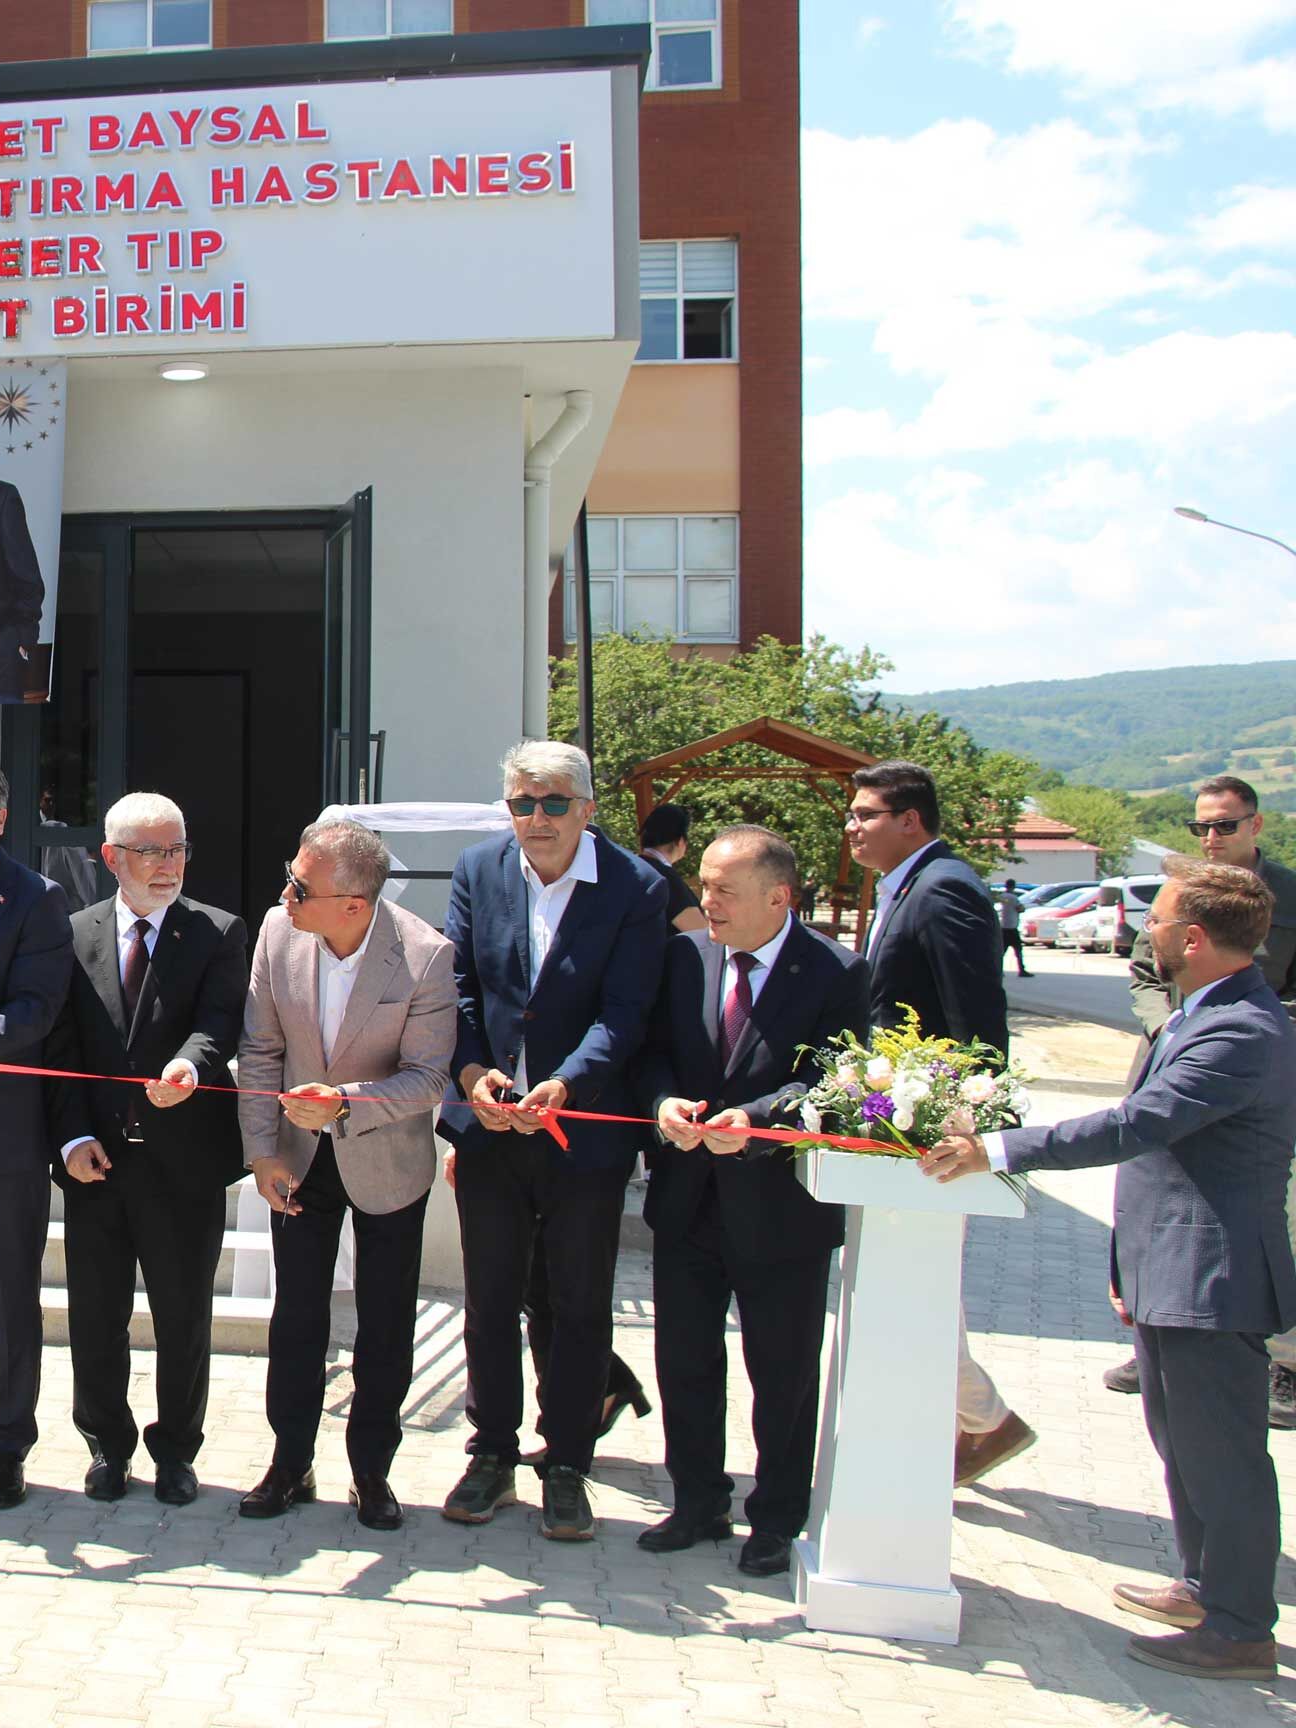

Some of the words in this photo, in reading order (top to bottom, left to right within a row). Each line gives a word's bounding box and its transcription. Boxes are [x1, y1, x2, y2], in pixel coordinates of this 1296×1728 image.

[88, 100, 329, 154] BAYSAL
[210, 140, 575, 206] HASTANESİ
[125, 228, 226, 271] TIP
[51, 281, 248, 338] BİRİMİ
